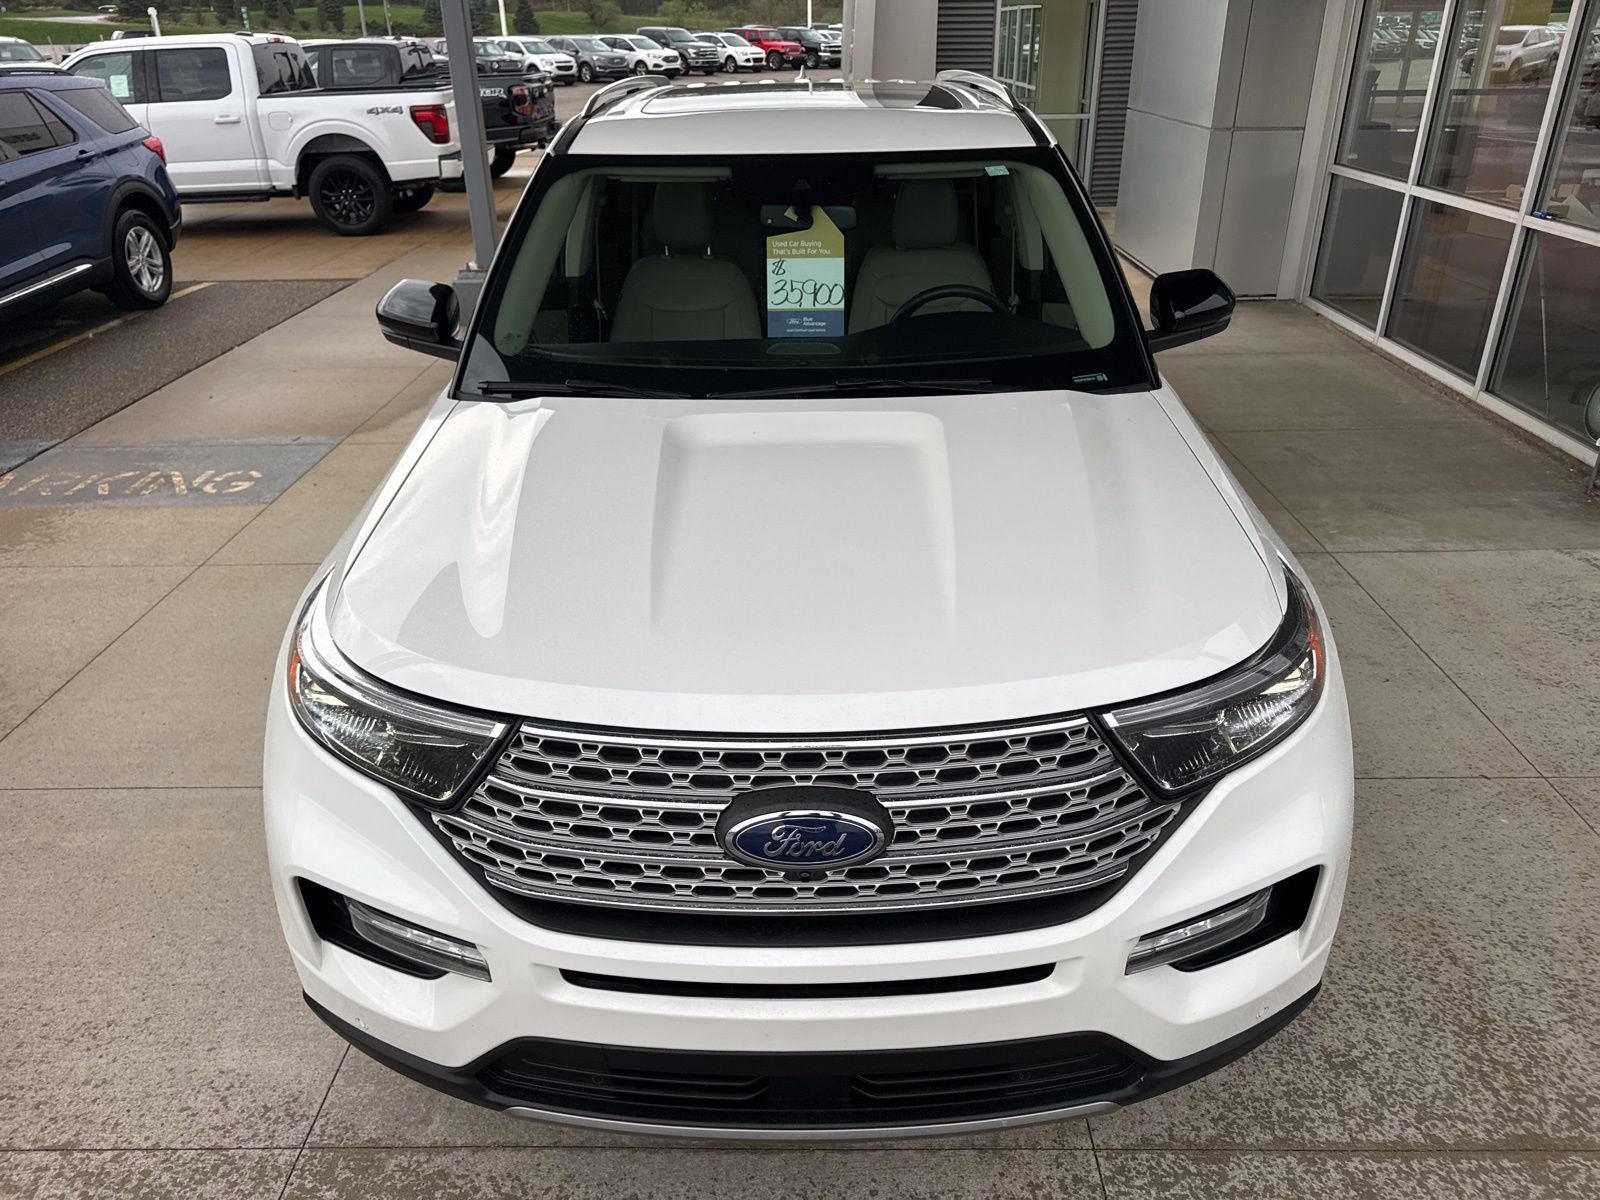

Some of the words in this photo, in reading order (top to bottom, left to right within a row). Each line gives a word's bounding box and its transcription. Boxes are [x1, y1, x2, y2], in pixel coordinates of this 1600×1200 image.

[772, 240, 788, 248] Used
[789, 240, 799, 248] Car
[800, 240, 822, 249] Buying
[771, 259, 787, 276] $
[771, 279, 844, 307] 35,900
[763, 824, 848, 858] Ford
